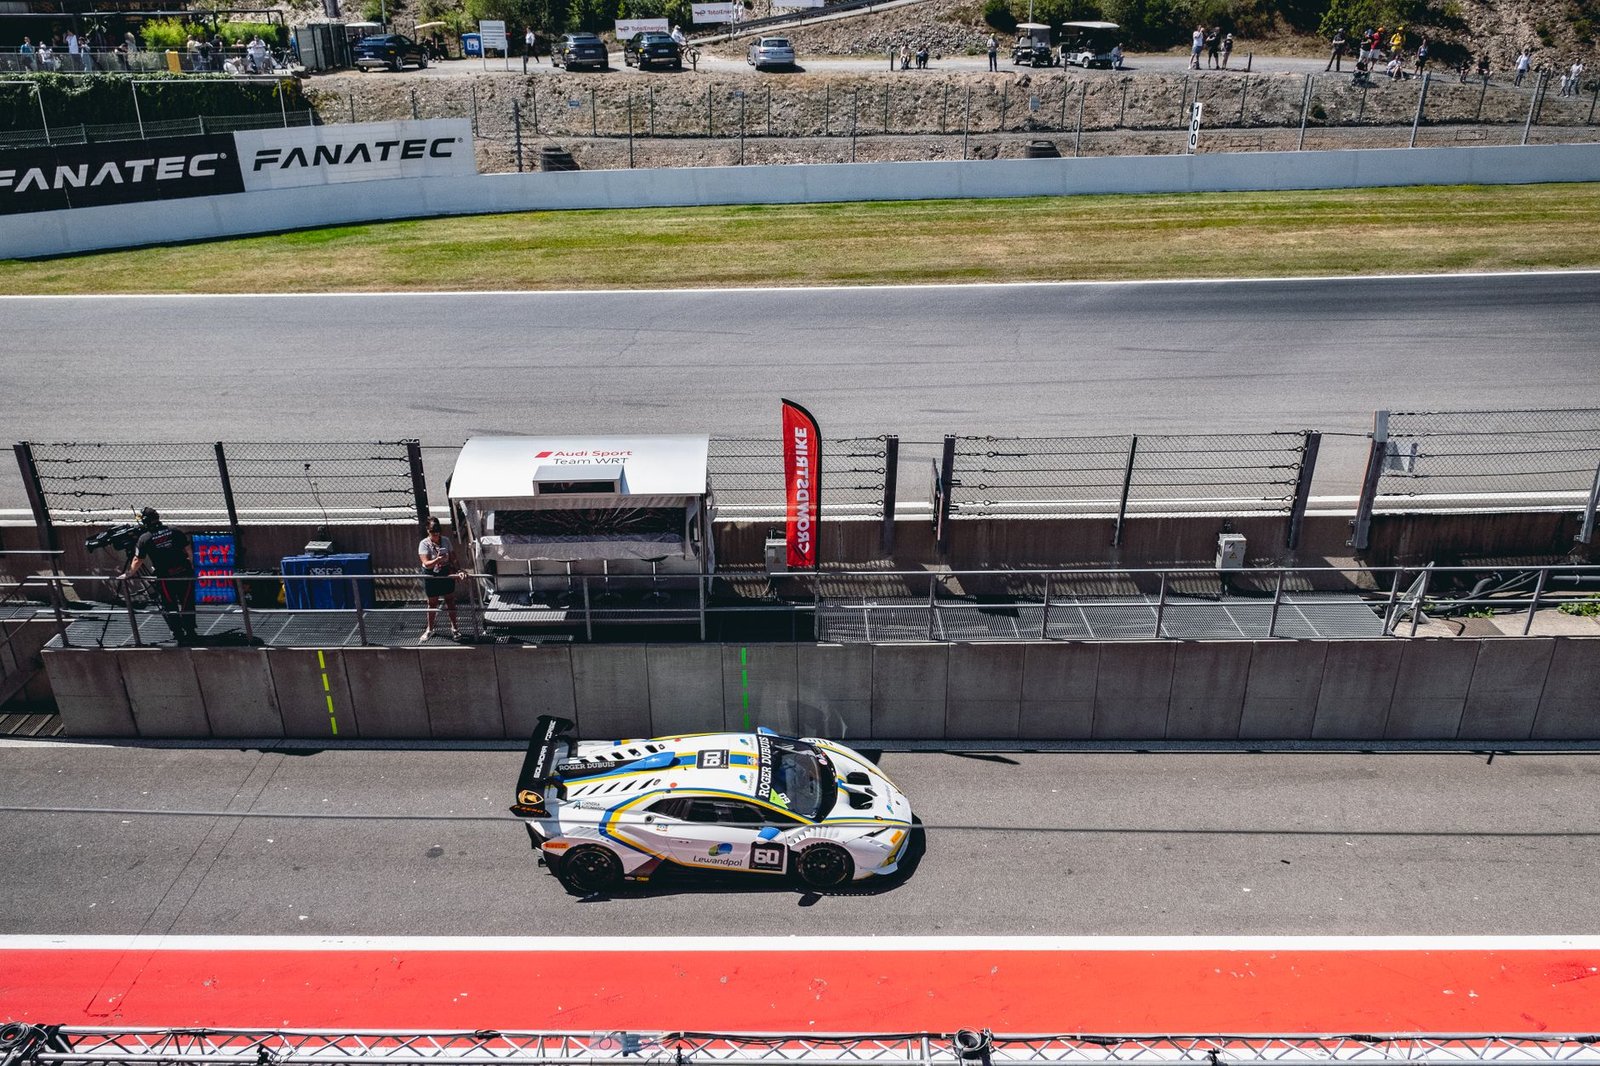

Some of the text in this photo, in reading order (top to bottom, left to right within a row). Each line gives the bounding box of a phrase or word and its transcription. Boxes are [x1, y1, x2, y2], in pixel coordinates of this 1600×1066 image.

[1190, 104, 1200, 146] 100
[253, 137, 456, 171] FANATEC
[592, 450, 633, 458] Sport
[198, 544, 231, 564] FCY
[559, 761, 616, 771] ROGER DUBUIS
[758, 736, 772, 798] ROGER DUBUIS
[693, 855, 743, 867] Lewandpol
[753, 848, 780, 865] 60
